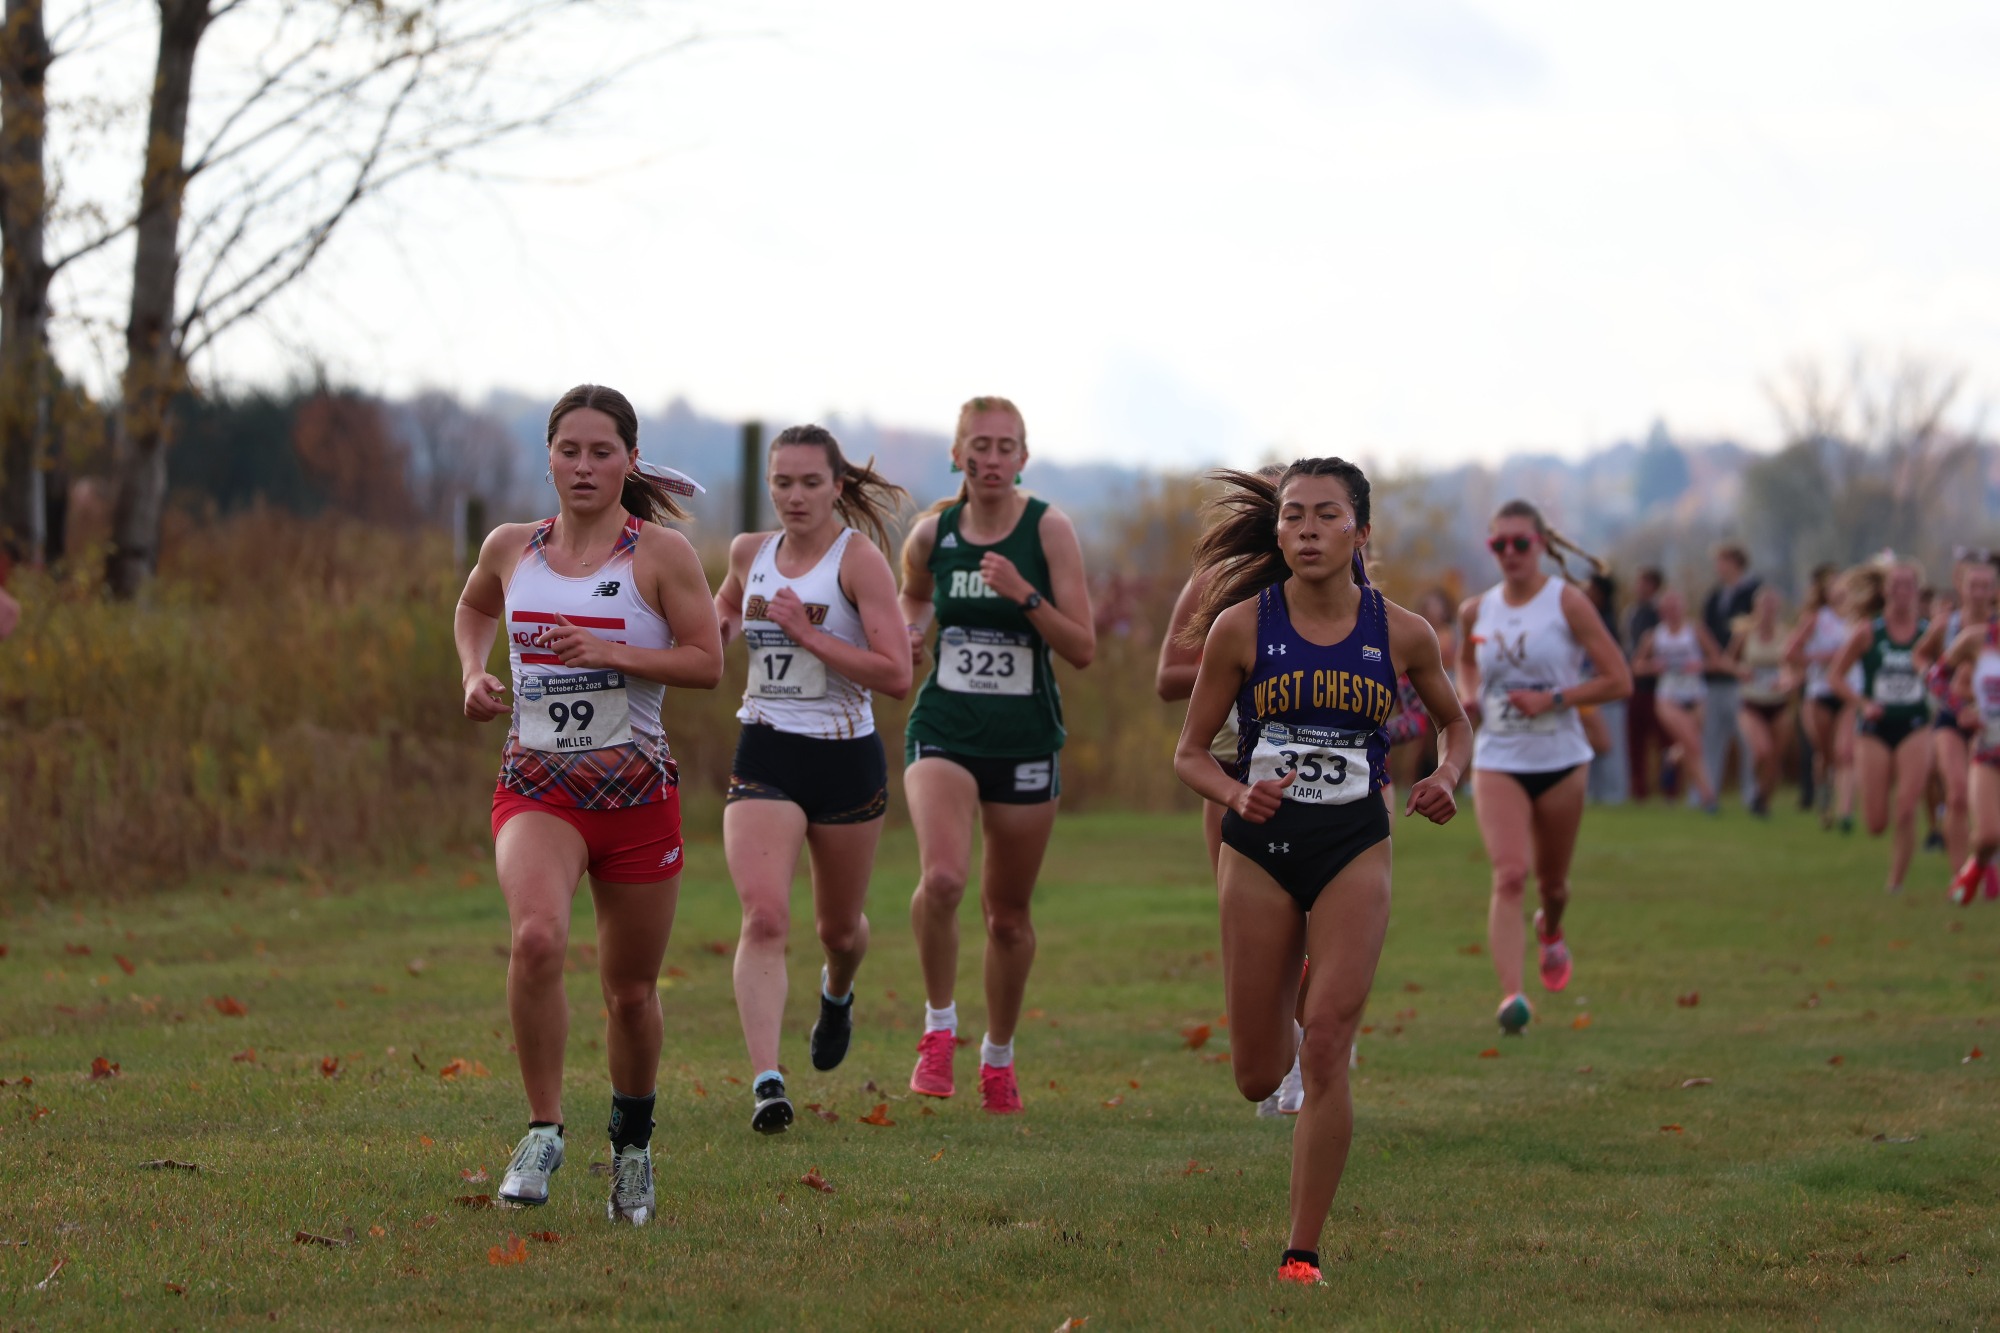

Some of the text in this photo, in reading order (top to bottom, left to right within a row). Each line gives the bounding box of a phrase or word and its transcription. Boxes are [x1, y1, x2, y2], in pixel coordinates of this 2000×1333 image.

[745, 595, 829, 625] BLM
[763, 653, 794, 681] 17
[957, 648, 1014, 678] 323
[548, 676, 578, 685] Edinboro,
[549, 685, 574, 693] October
[586, 682, 602, 690] 2025
[1254, 669, 1392, 728] WEST CHESTER
[548, 700, 595, 733] 99
[556, 736, 593, 749] MILLER
[1296, 728, 1329, 738] Edinboro,
[1297, 736, 1324, 745] October
[1014, 761, 1050, 791] S
[1274, 750, 1348, 785] 353
[1292, 785, 1323, 800] TAPIA
